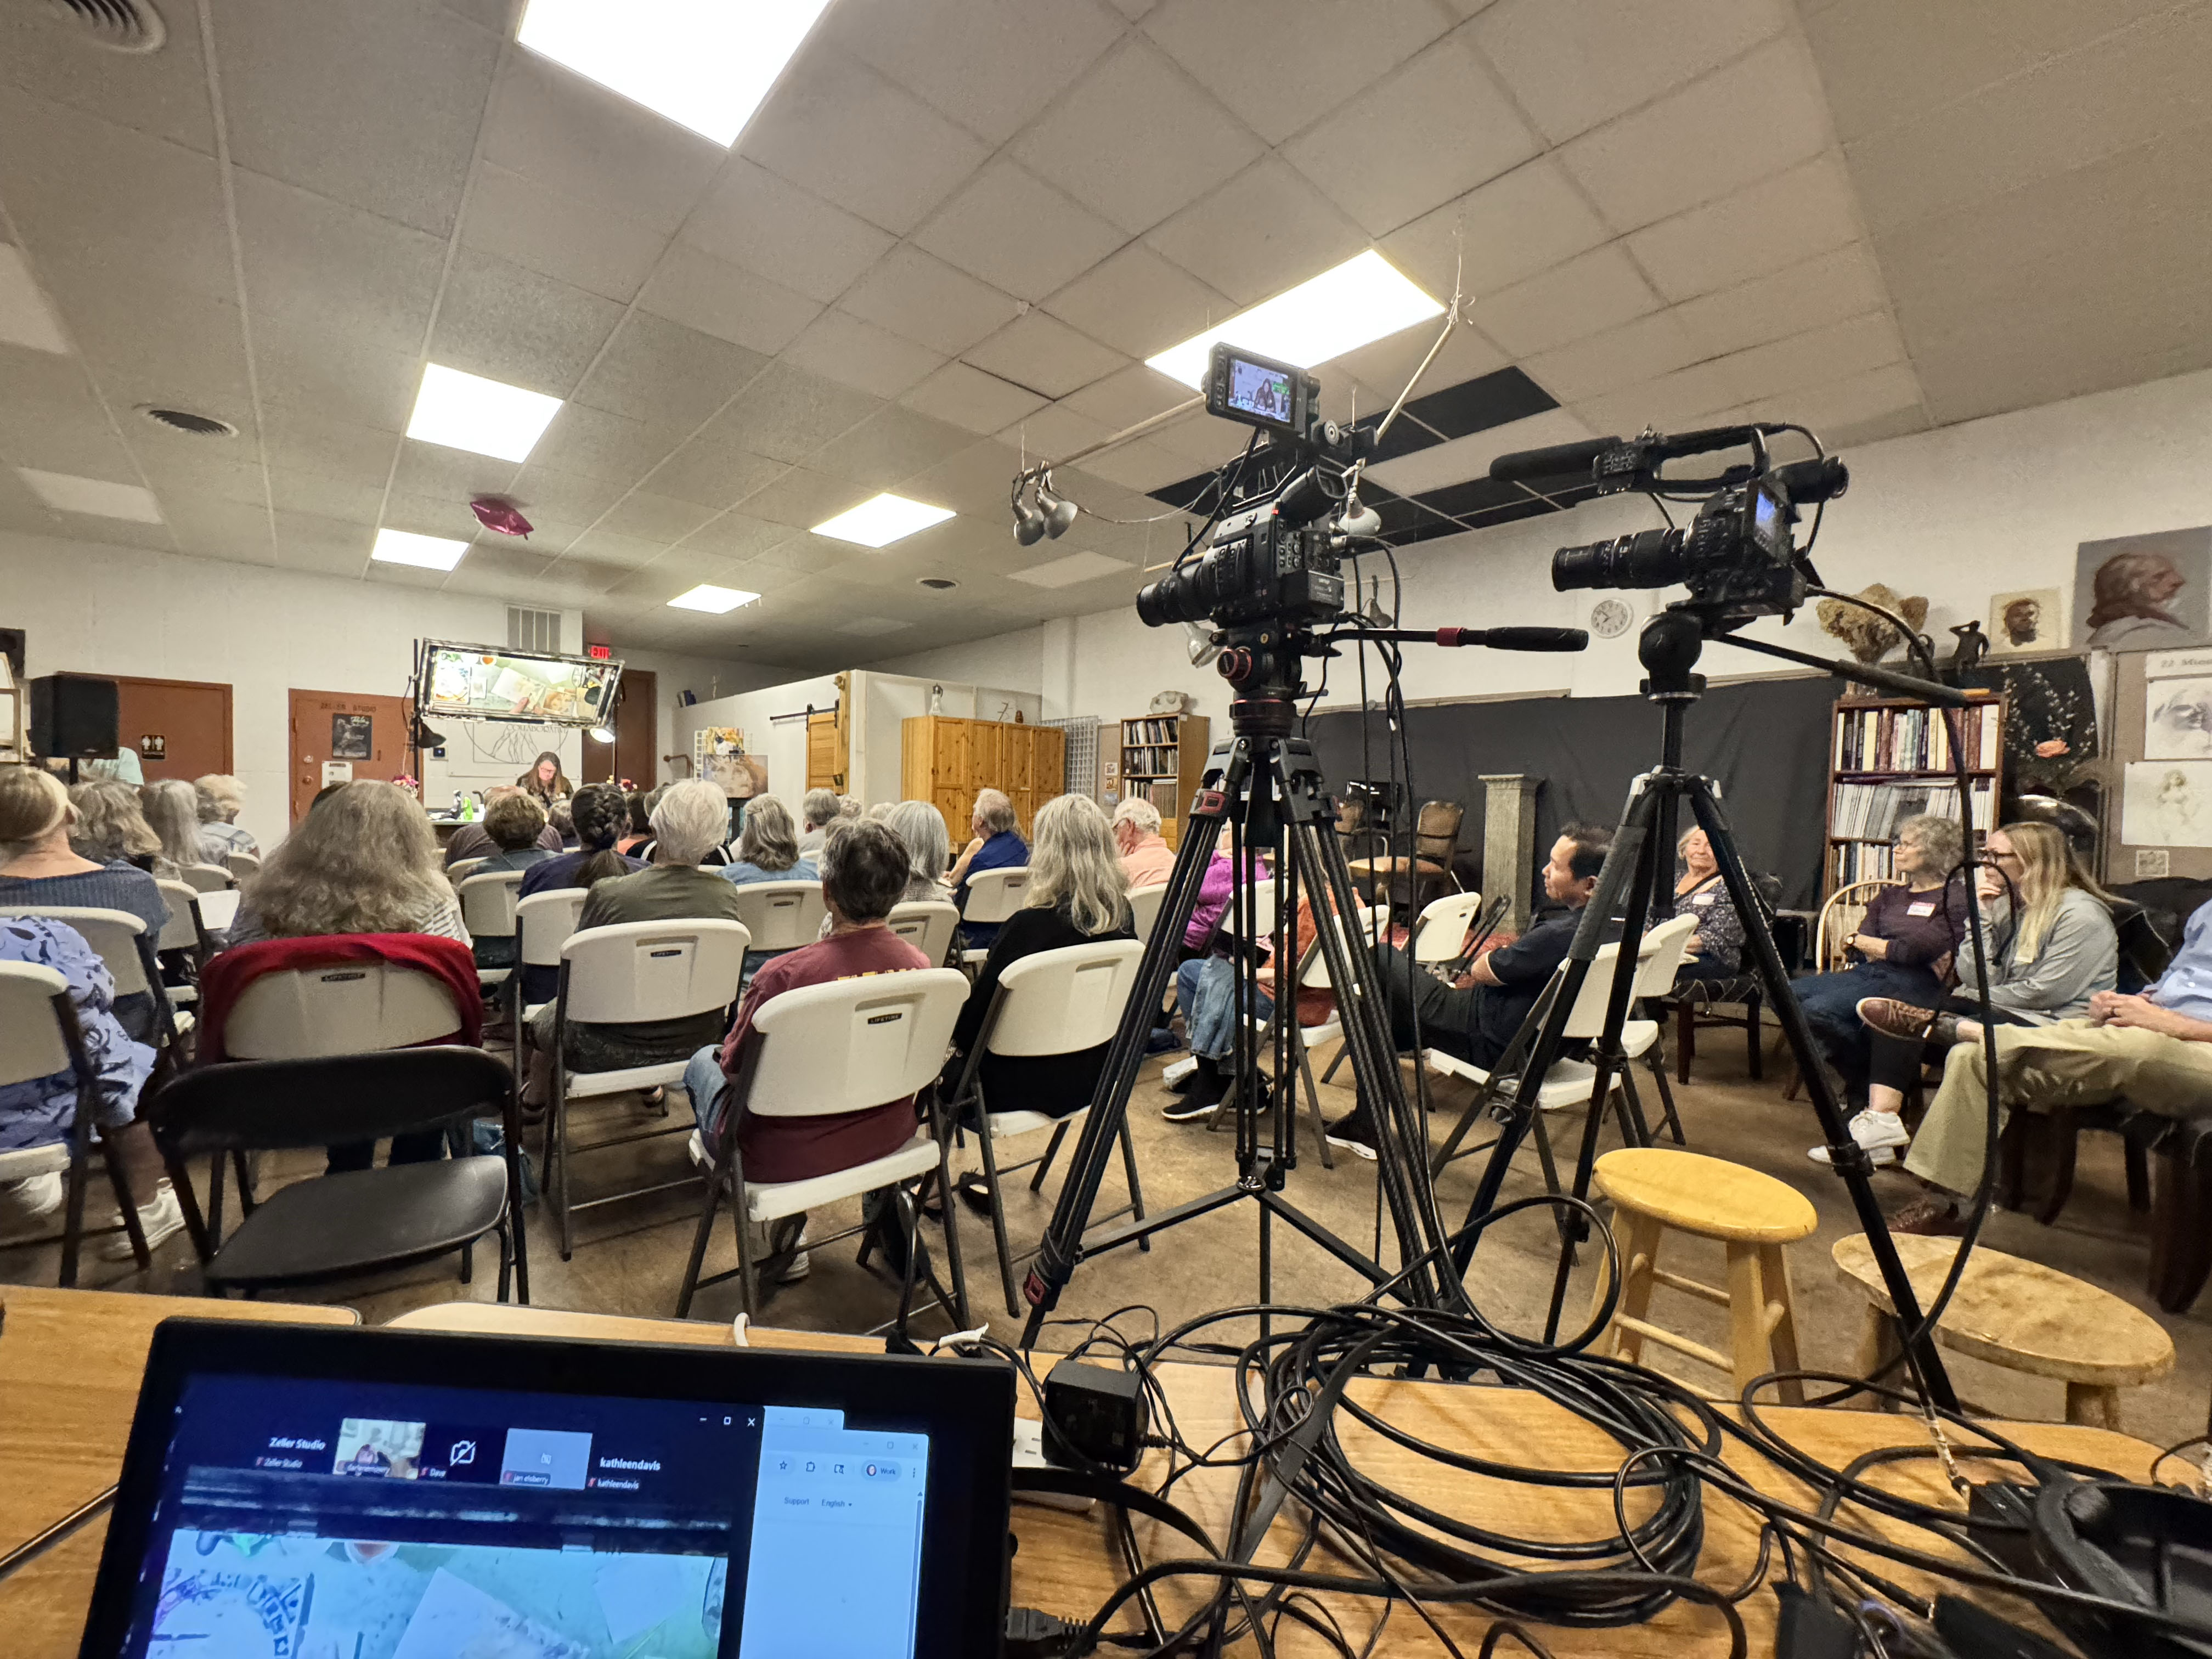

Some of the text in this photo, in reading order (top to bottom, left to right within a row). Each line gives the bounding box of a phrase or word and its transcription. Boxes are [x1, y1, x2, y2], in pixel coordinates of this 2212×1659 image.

[591, 646, 609, 659] EXIT
[870, 1014, 899, 1023] LIFETIME
[268, 1437, 326, 1451] Zeller Studio
[600, 1457, 661, 1470] kathleendavis
[597, 1478, 639, 1489] kathleendavis
[784, 1497, 845, 1508] Support English
